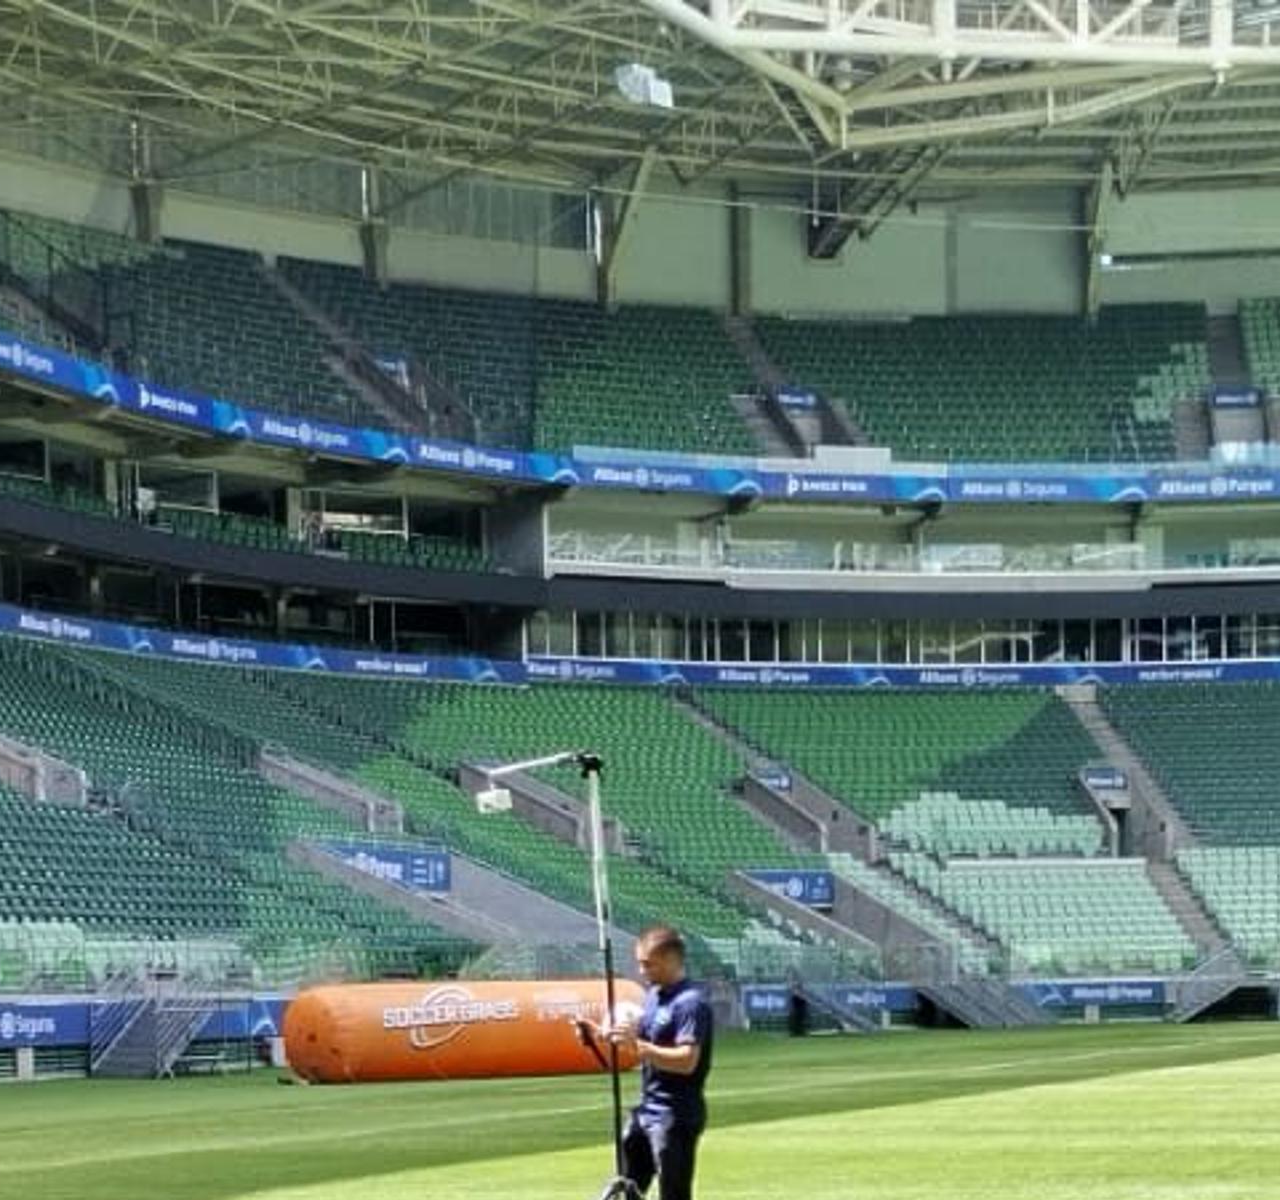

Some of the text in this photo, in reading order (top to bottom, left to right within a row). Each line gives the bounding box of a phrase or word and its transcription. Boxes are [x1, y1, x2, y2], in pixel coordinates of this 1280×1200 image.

[420, 444, 514, 472] Allianz Parque
[594, 468, 692, 487] Allianz Seguros
[1160, 478, 1273, 494] Allianz Parque
[962, 481, 1067, 497] Allianz Seguros
[173, 638, 257, 662] Allianz Seguros
[17, 1013, 56, 1039] Seguros
